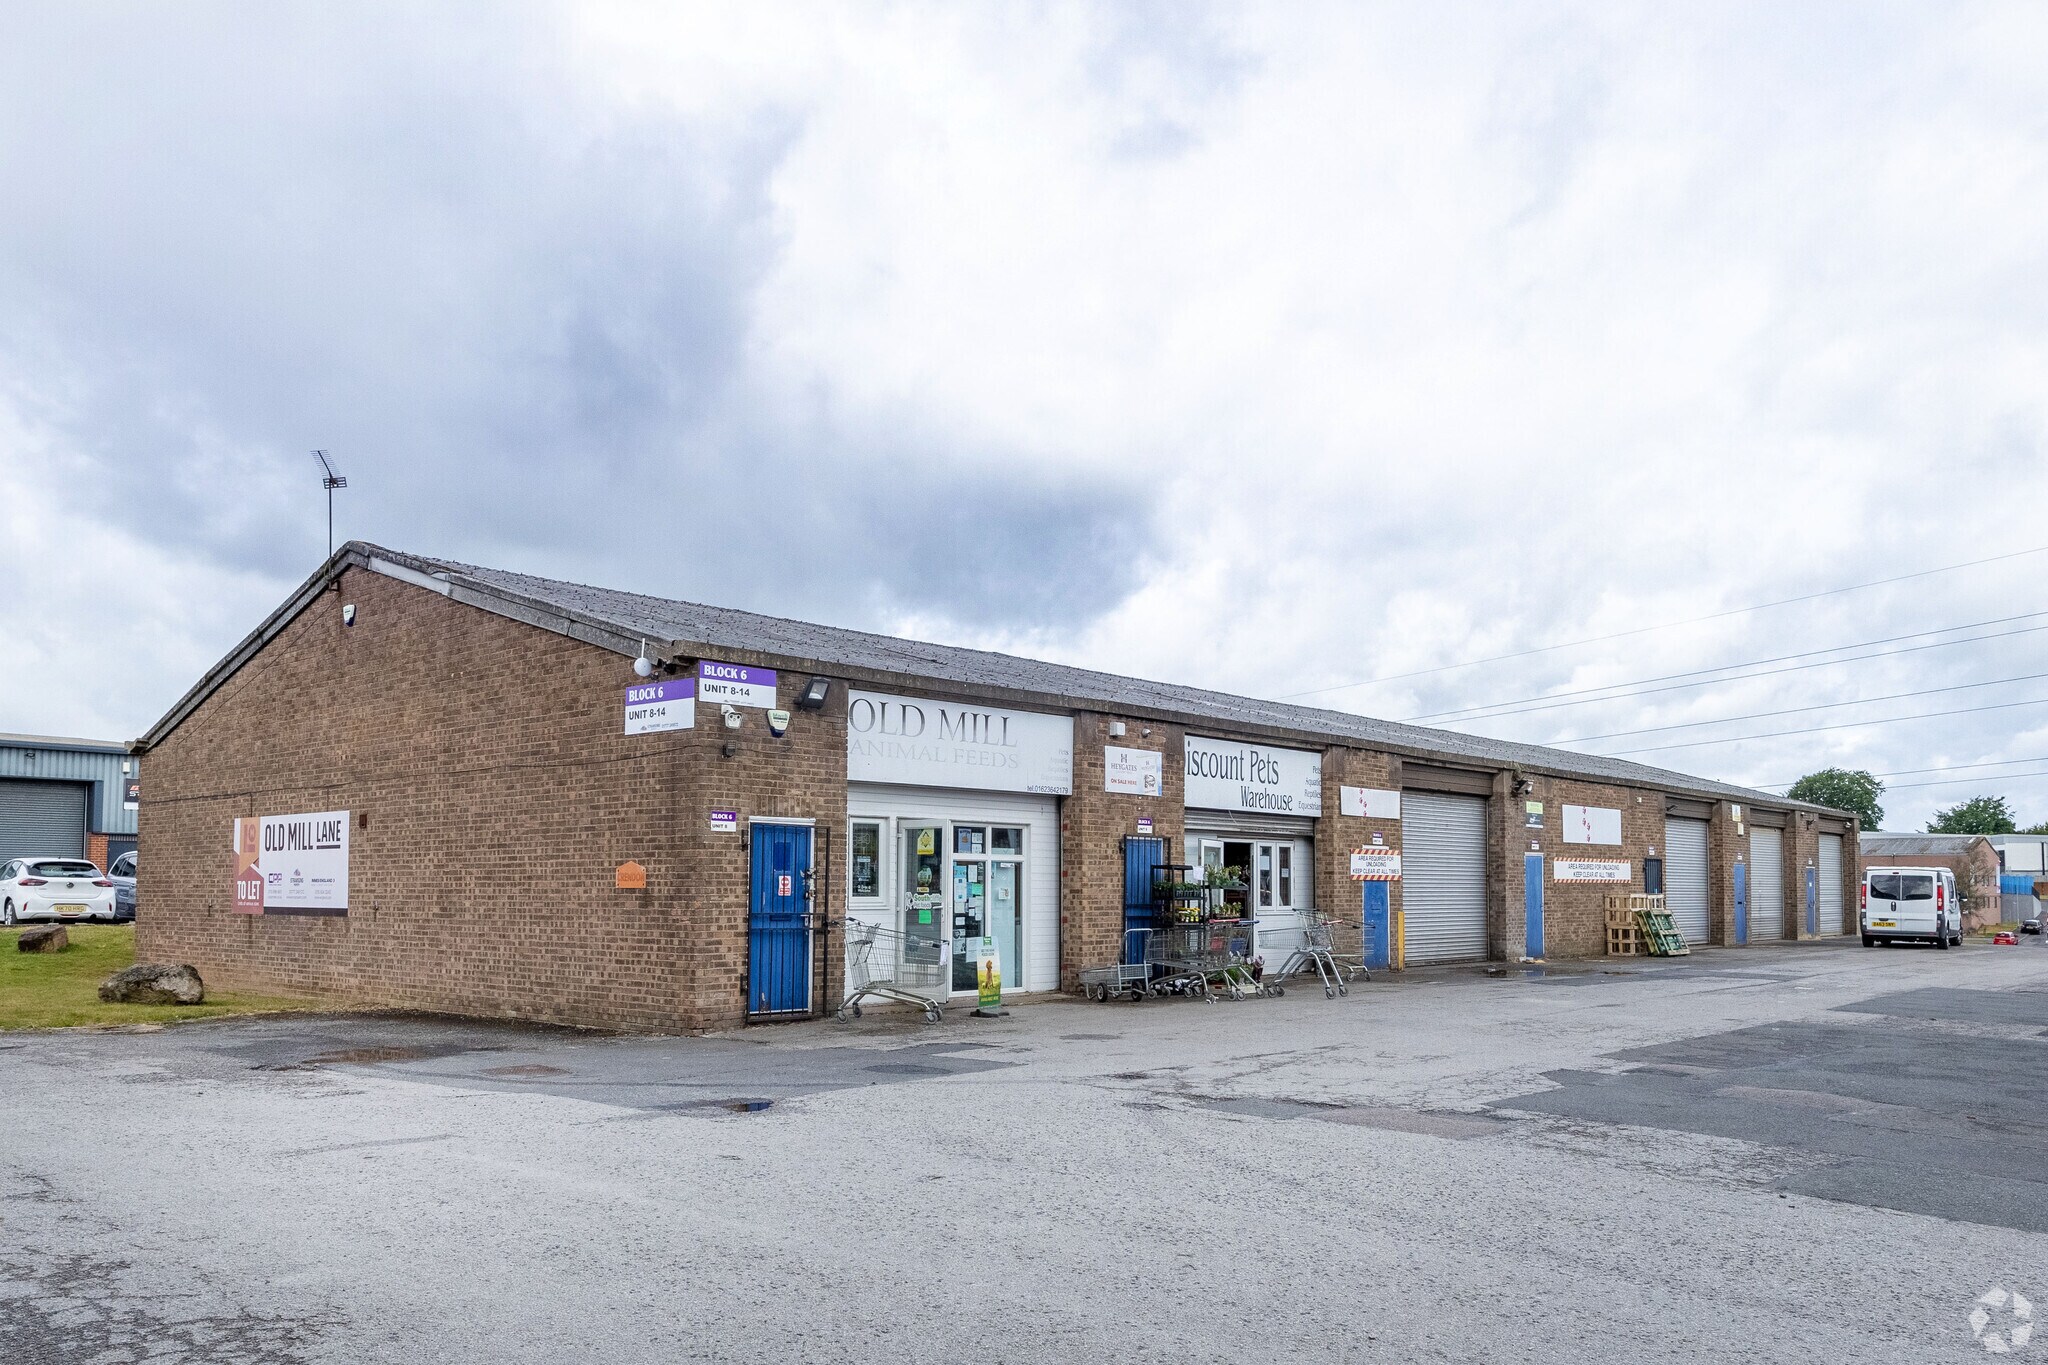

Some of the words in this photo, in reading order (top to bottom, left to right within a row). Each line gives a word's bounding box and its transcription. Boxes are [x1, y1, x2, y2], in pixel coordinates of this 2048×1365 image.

[704, 664, 738, 679] BLOCK
[740, 669, 748, 681] 6
[628, 687, 656, 702] BLOCK
[657, 686, 664, 698] 6
[704, 683, 728, 694] UNIT
[730, 686, 751, 697] 8-14
[628, 709, 648, 721] UNIT
[649, 707, 666, 718] 8-14
[849, 698, 926, 738] OLD
[938, 708, 1018, 748] MILL
[849, 738, 947, 763] ANIMAL
[953, 748, 1019, 769] FEEDS
[1110, 763, 1138, 772] HEYGATES
[1250, 750, 1279, 785] Pets
[1312, 765, 1322, 775] Pets
[1240, 785, 1293, 811] Warehouse
[264, 823, 285, 852] OLD
[288, 822, 314, 851] MILL
[316, 820, 341, 842] LANE
[237, 880, 246, 900] TO
[247, 880, 260, 900] LET
